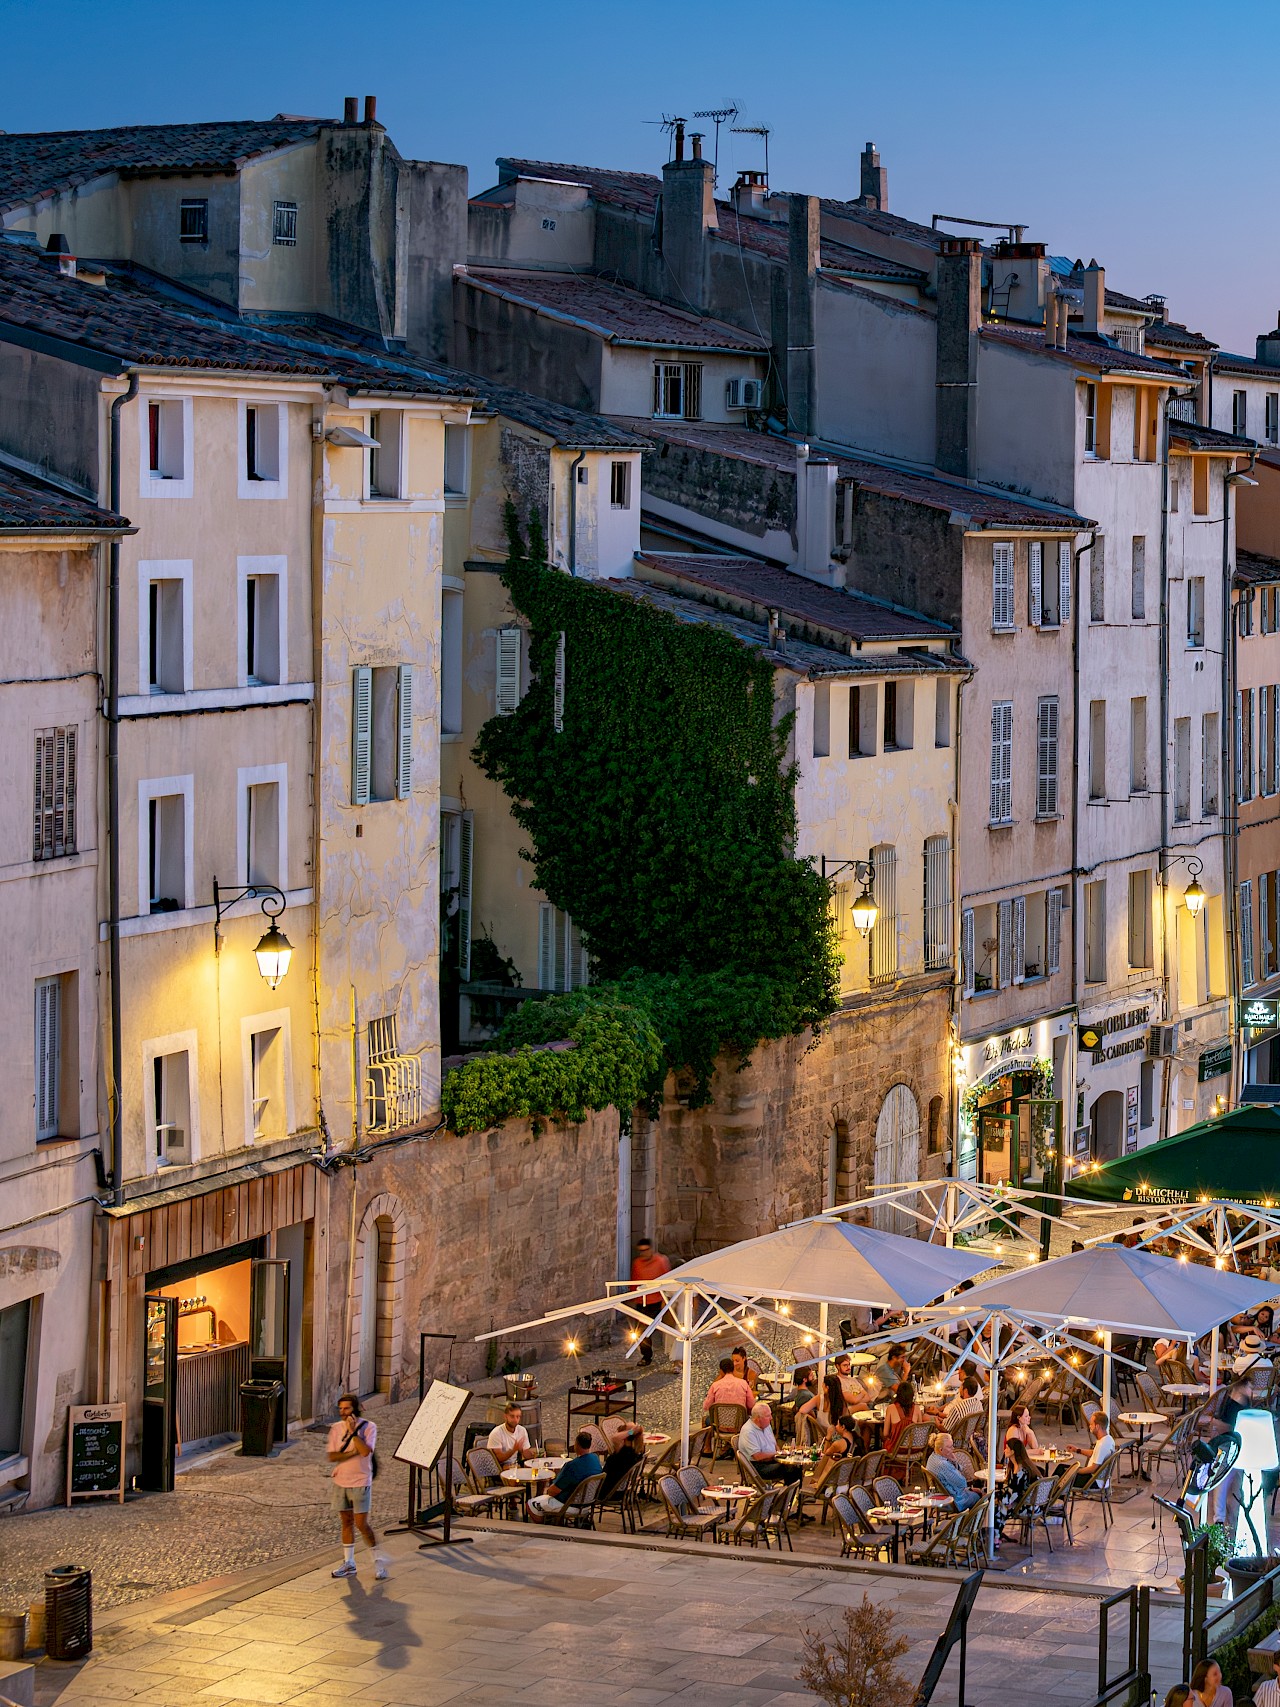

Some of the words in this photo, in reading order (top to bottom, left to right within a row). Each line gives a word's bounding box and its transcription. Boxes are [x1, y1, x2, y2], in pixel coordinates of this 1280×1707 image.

[985, 1043, 998, 1060] Di
[999, 1027, 1033, 1056] Micheli
[1106, 1036, 1146, 1060] CARDEURS
[1135, 1187, 1146, 1196] DI
[1137, 1196, 1187, 1205] RISTORANTE
[83, 1409, 112, 1420] Carlsberg
